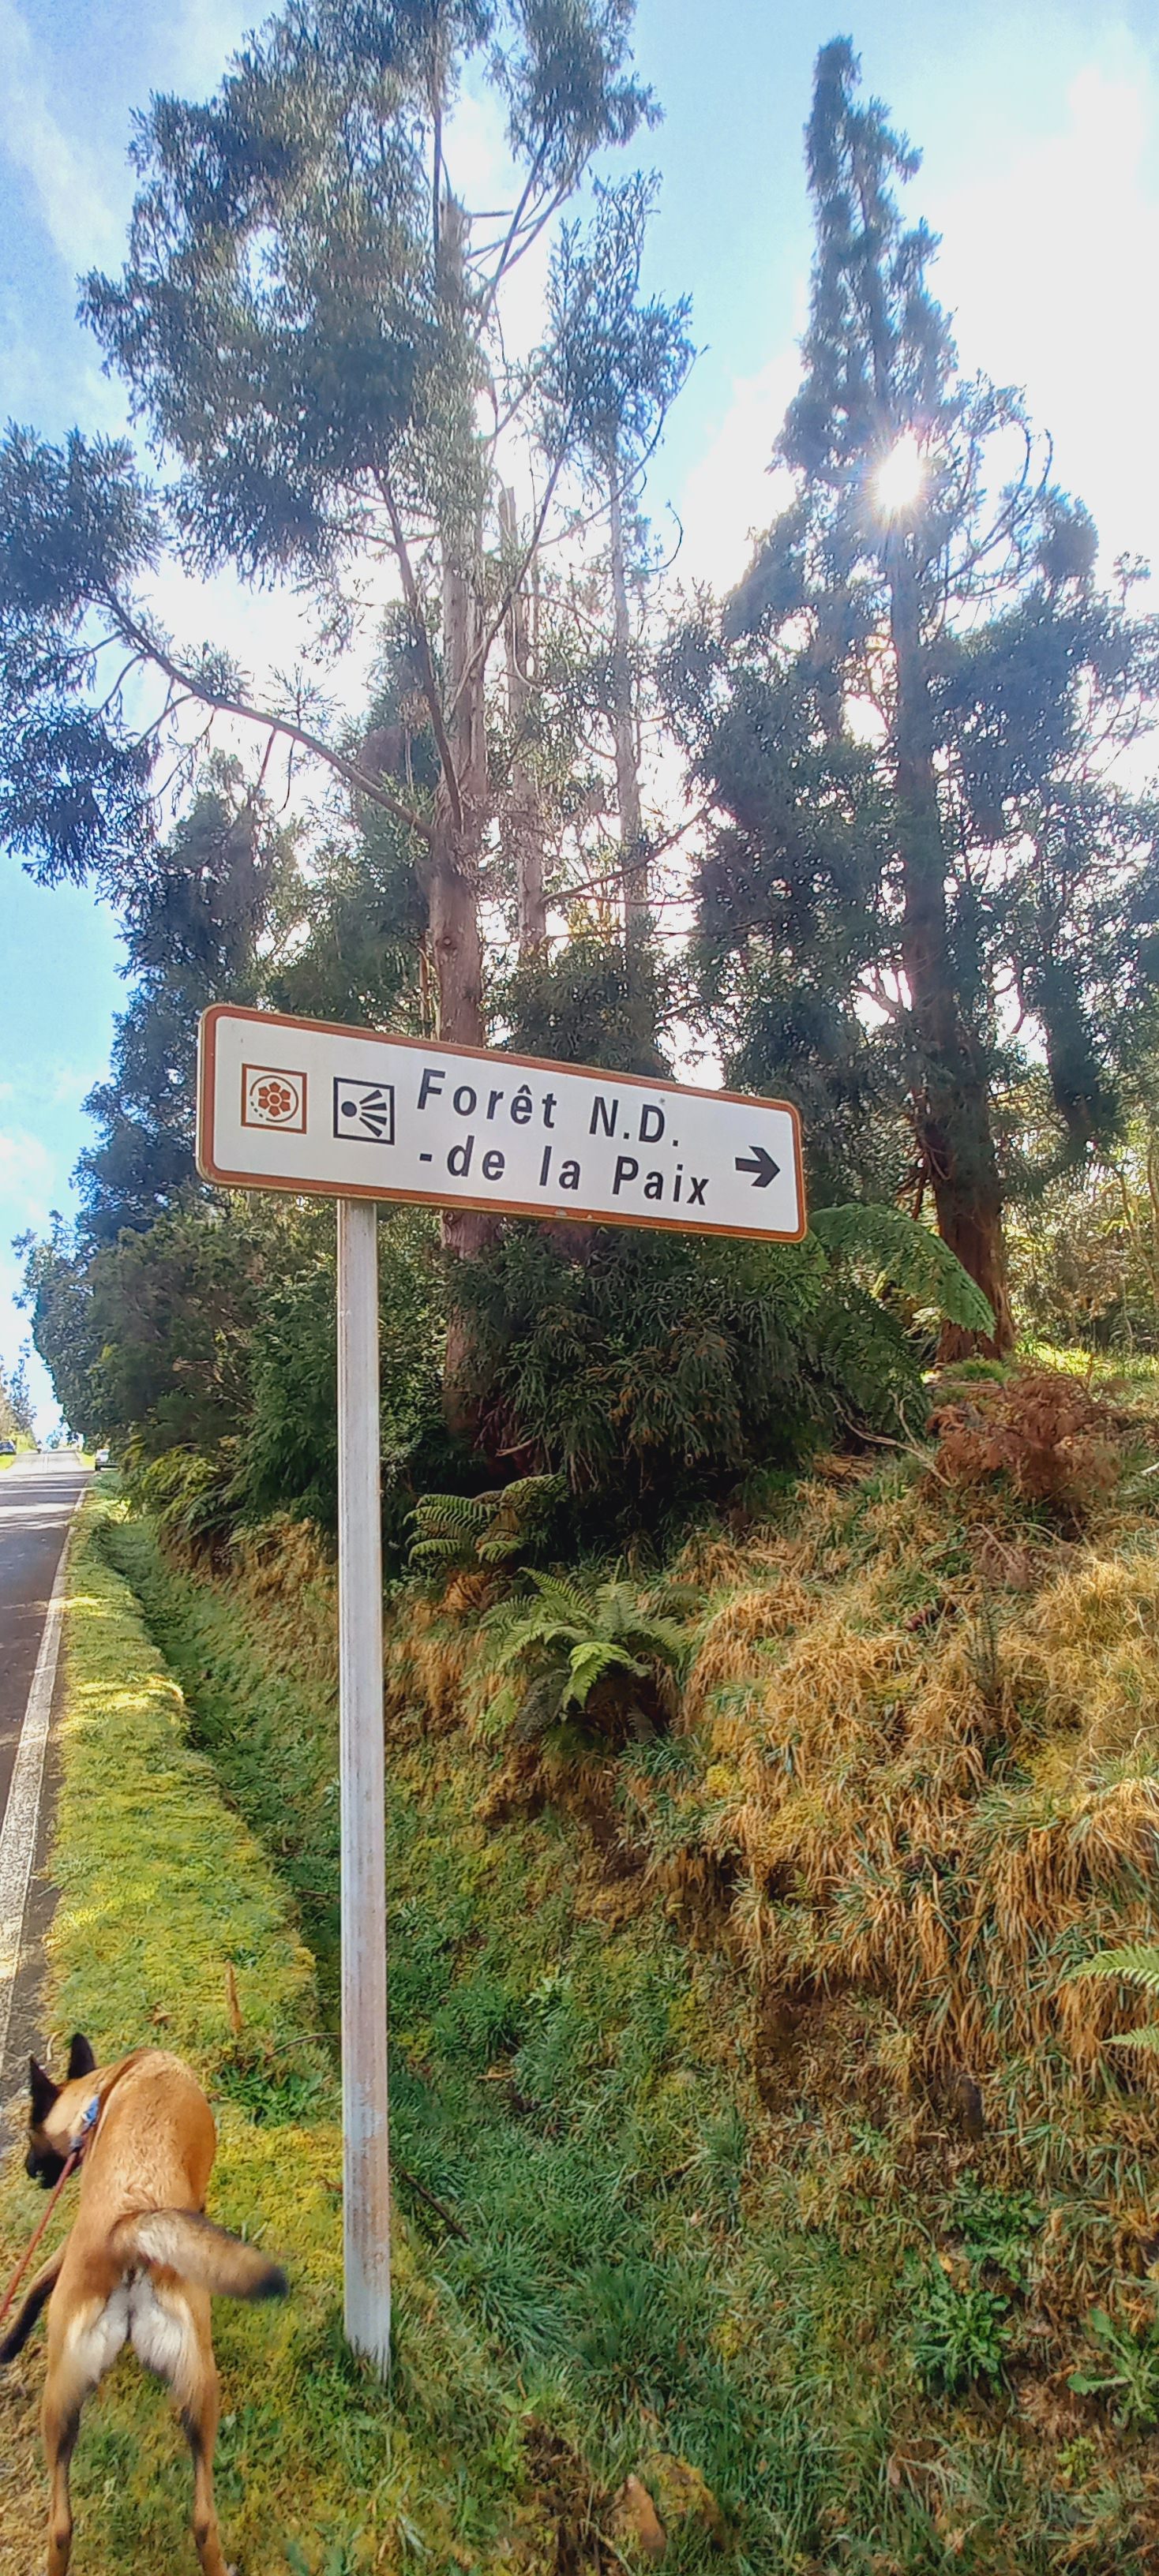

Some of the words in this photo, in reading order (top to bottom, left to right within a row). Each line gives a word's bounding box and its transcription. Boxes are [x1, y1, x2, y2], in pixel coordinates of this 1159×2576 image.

[416, 1068, 557, 1129] Forêt
[589, 1095, 679, 1148] N.D.
[539, 1145, 581, 1190] la
[612, 1155, 711, 1207] Paix
